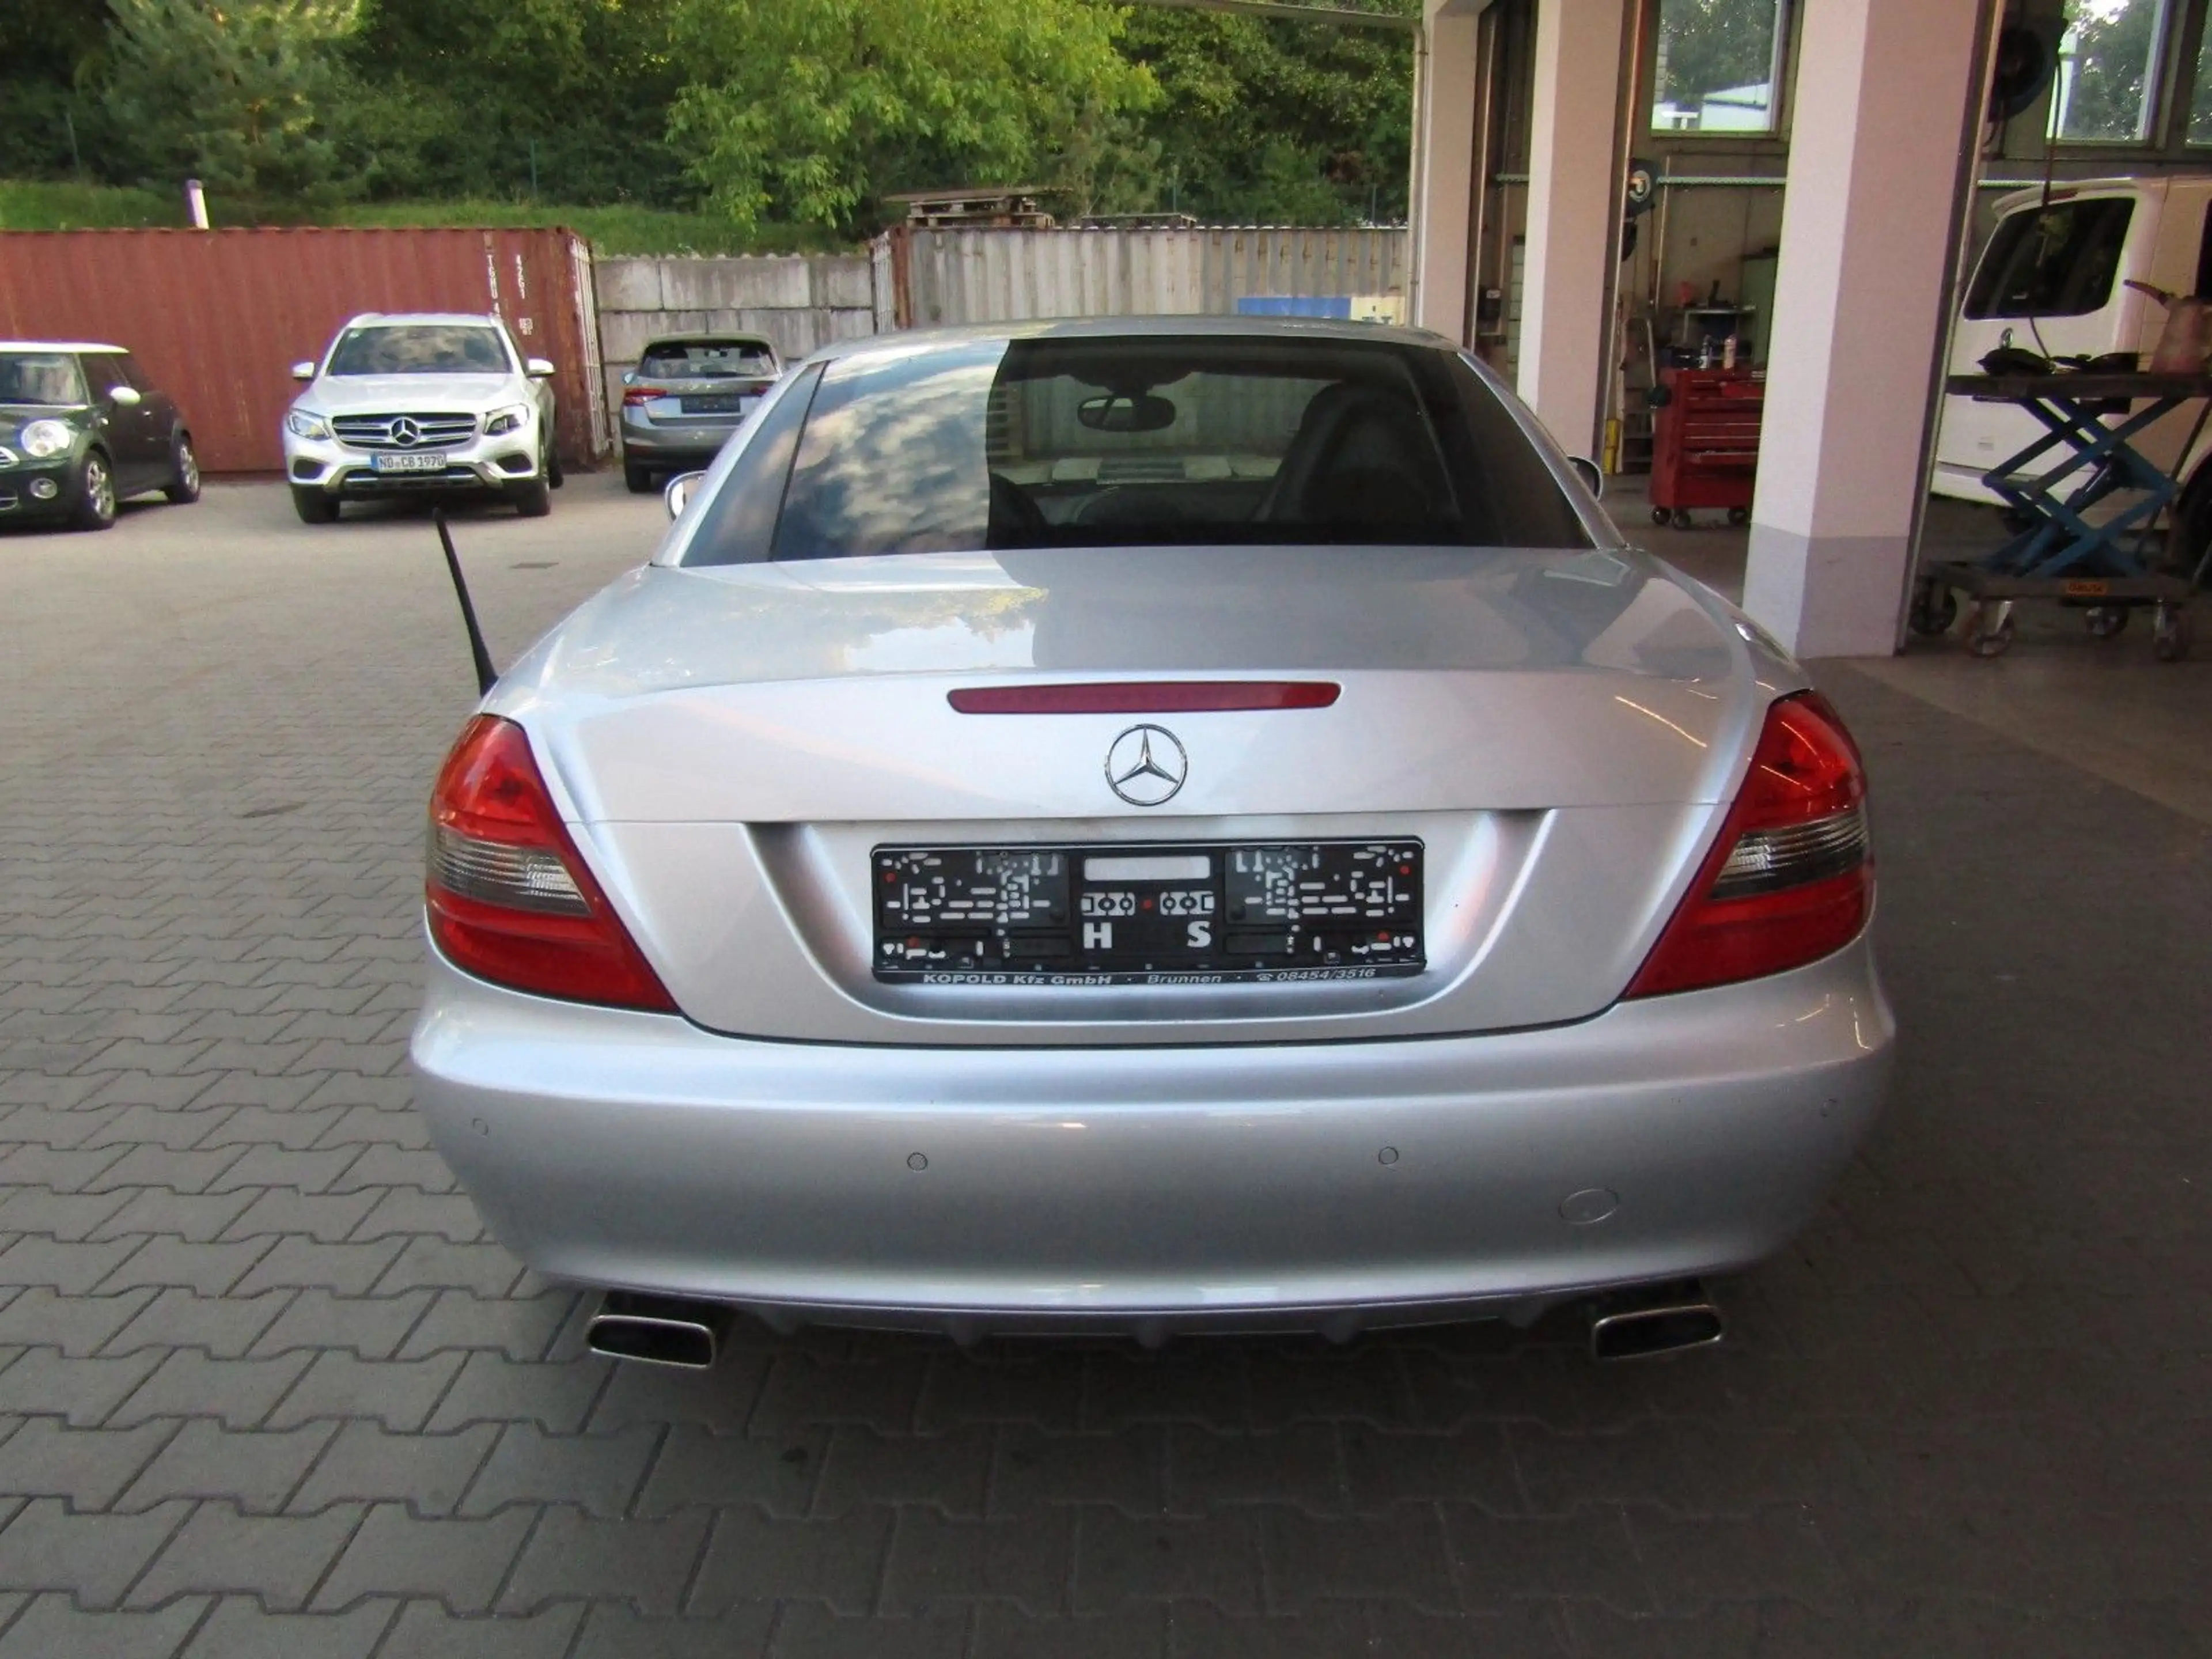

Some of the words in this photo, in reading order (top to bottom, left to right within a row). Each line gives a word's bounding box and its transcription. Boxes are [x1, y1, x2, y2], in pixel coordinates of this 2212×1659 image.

[1084, 922, 1112, 949] H
[1186, 921, 1211, 948] S
[923, 974, 1006, 984] KOPOLD
[1013, 975, 1045, 984] Kfz
[1050, 975, 1112, 985] GmbH
[1147, 974, 1222, 984] Brunnen
[1276, 968, 1376, 981] 08454/3516
